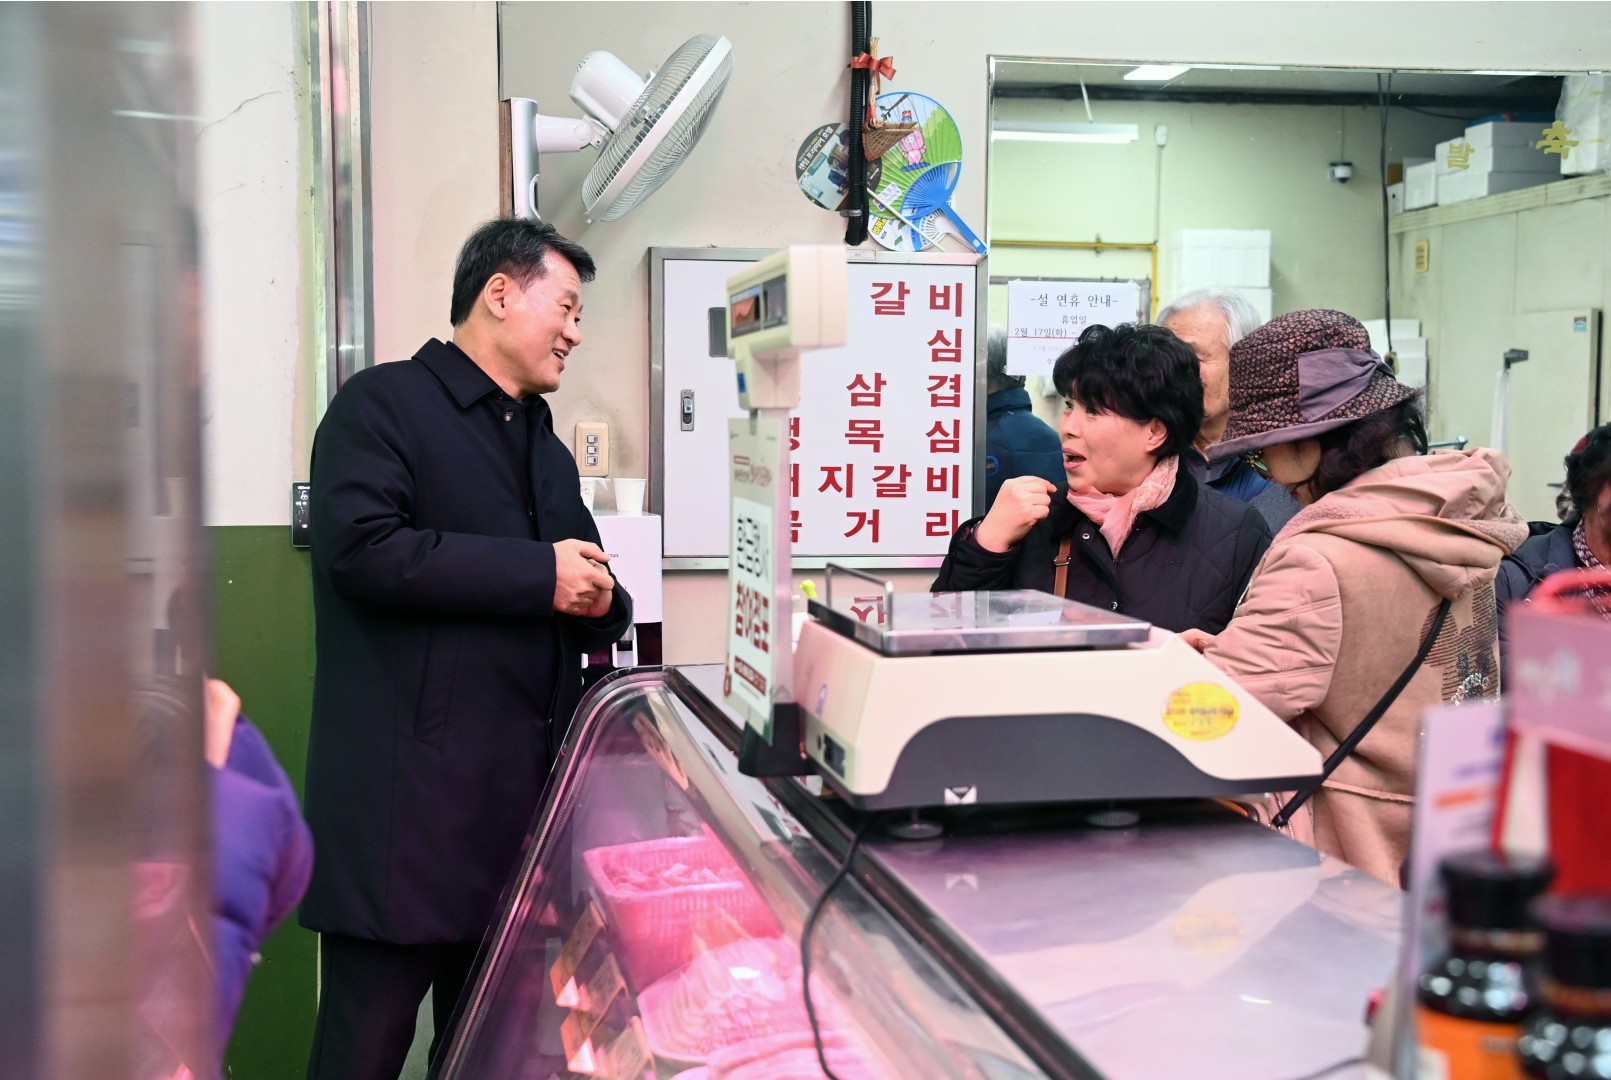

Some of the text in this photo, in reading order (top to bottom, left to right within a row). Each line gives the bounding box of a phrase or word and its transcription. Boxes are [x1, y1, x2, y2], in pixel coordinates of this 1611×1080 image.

[805, 136, 826, 160] 프리미어
[1056, 293, 1081, 307] 연휴
[1061, 315, 1087, 325] 휴업일
[1014, 328, 1028, 337] 2월
[1034, 327, 1067, 338] 17일(화)
